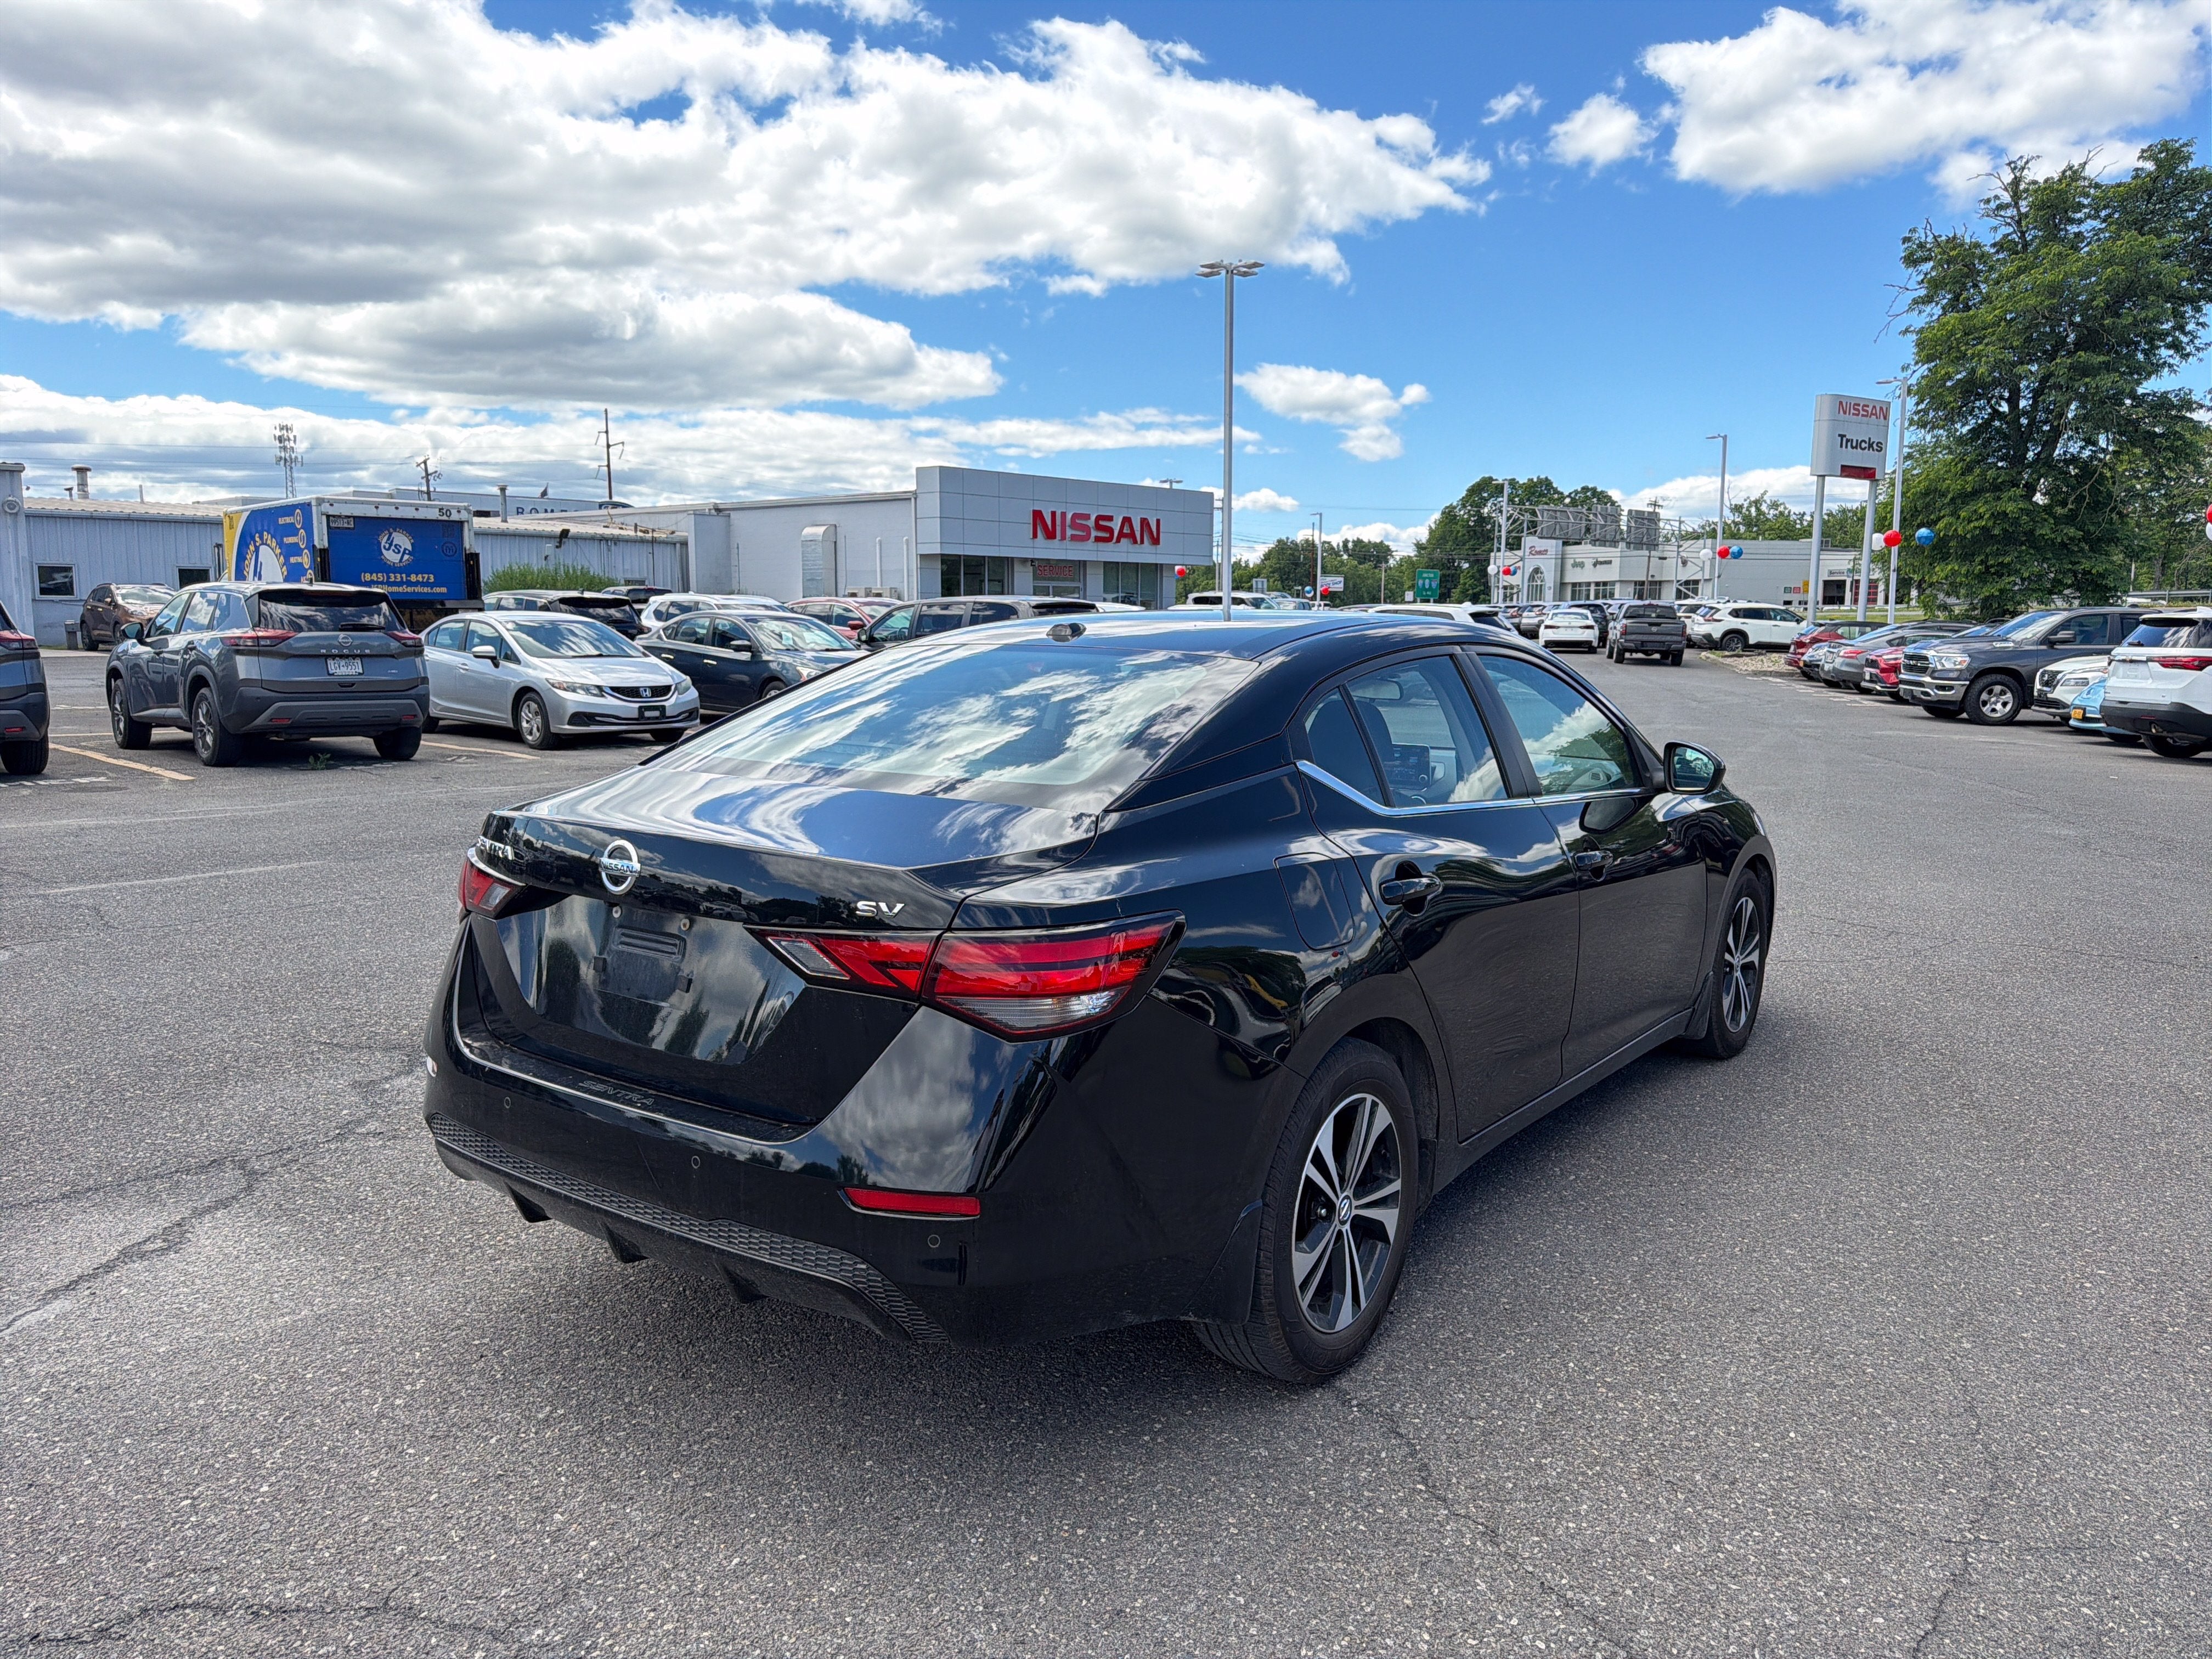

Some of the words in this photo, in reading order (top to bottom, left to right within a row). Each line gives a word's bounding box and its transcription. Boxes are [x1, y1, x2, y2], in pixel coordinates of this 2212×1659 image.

[1838, 400, 1888, 420] NISSAN
[1838, 433, 1883, 453] Trucks
[438, 509, 452, 517] 50
[1031, 509, 1161, 546] NISSAN
[378, 530, 389, 542] JOHN
[396, 528, 414, 544] PARKER
[243, 540, 255, 580] JOHN
[263, 531, 288, 580] PARKER
[381, 555, 393, 566] HOME
[394, 556, 414, 567] SERVICES
[1037, 564, 1074, 577] SERVICE
[1571, 558, 1585, 569] Jeep
[361, 572, 387, 582] (845)
[389, 573, 435, 582] 331-8473
[600, 861, 634, 873] NISSAN
[855, 901, 905, 918] SV
